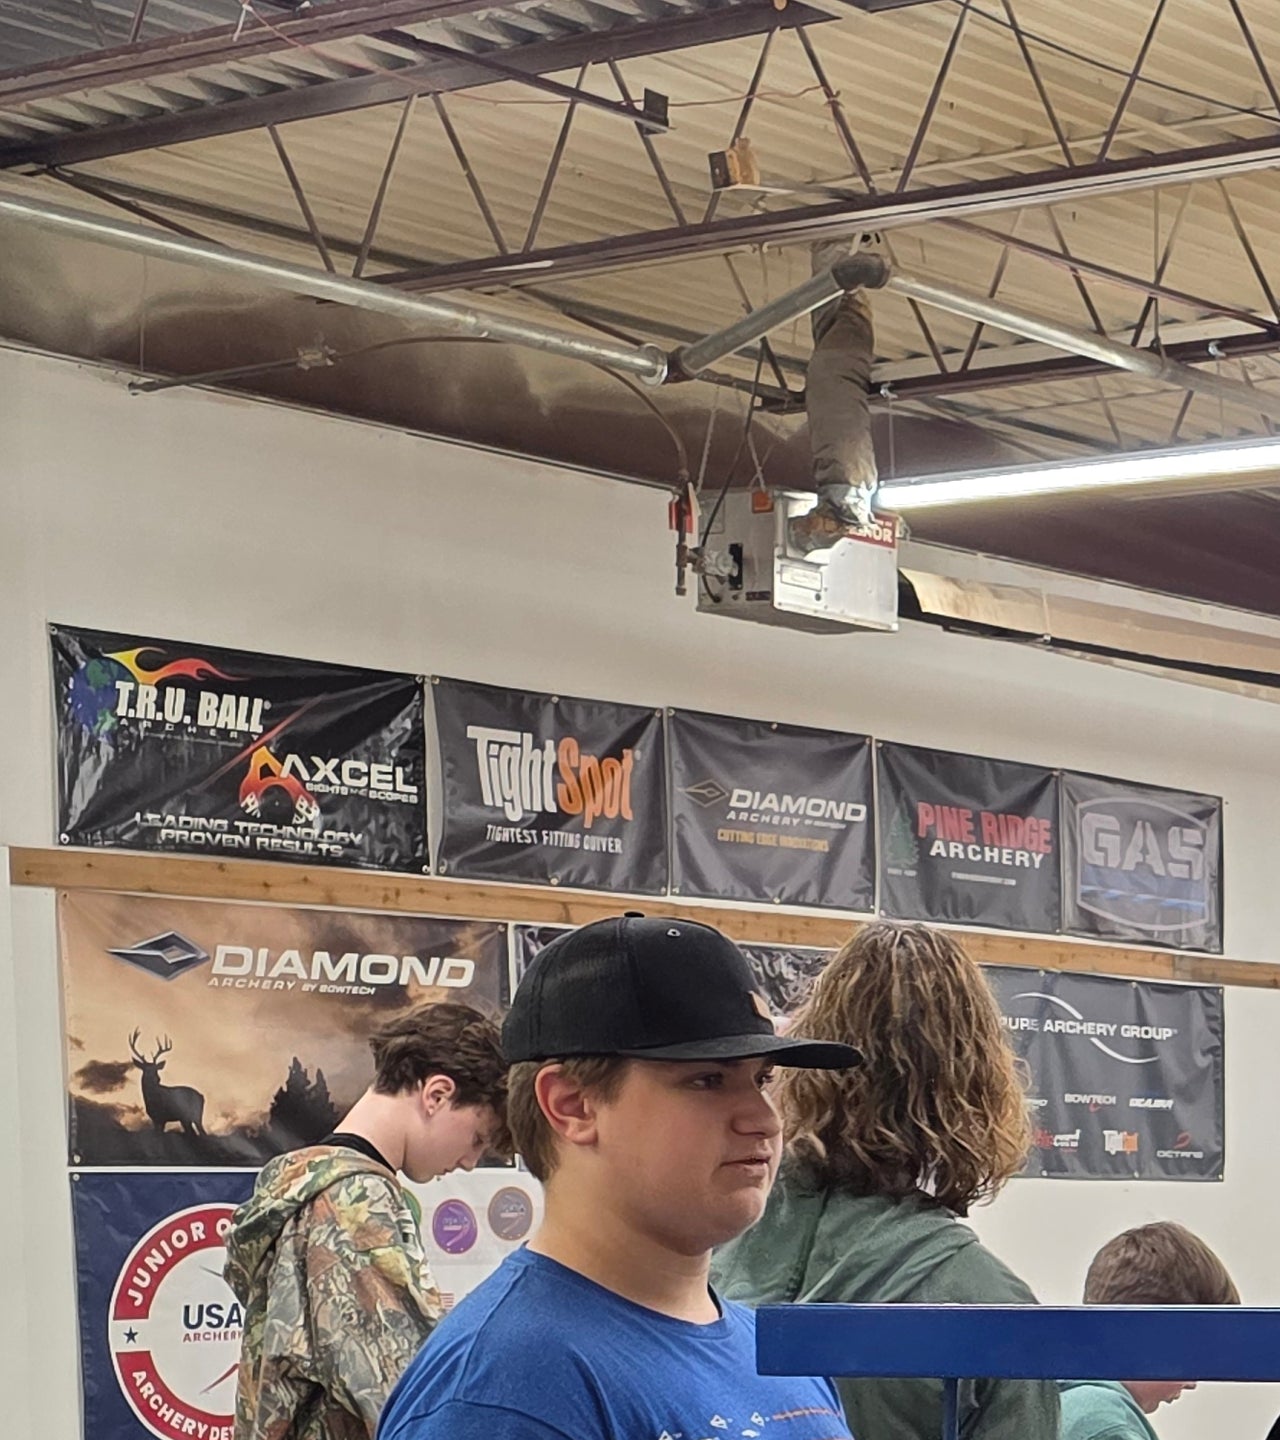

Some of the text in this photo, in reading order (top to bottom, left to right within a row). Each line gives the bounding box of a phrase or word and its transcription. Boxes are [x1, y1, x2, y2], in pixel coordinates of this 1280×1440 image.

[115, 680, 191, 724] T.R.U.
[280, 753, 418, 794] AXCEL
[727, 810, 801, 827] ARCHERY
[728, 788, 867, 822] DIAMOND
[135, 811, 363, 846] LEADING TECHNOLOGY
[160, 829, 345, 858] PROVEN RESULTS
[486, 824, 623, 854] TIGHTEST FITTING QUIVER
[917, 801, 1053, 854] PINE RIDGE
[929, 839, 1045, 869] ARCHERY
[1081, 812, 1204, 881] GAS
[211, 944, 475, 988] DIAMOND
[207, 976, 377, 996] ARCHERY BY BOWTECH
[1042, 1018, 1118, 1037] ARCHERY
[1120, 1024, 1174, 1041] GROUP
[127, 1220, 206, 1307] JUNIOR
[183, 1302, 243, 1330] USA
[132, 1370, 209, 1440] ARCHERY
